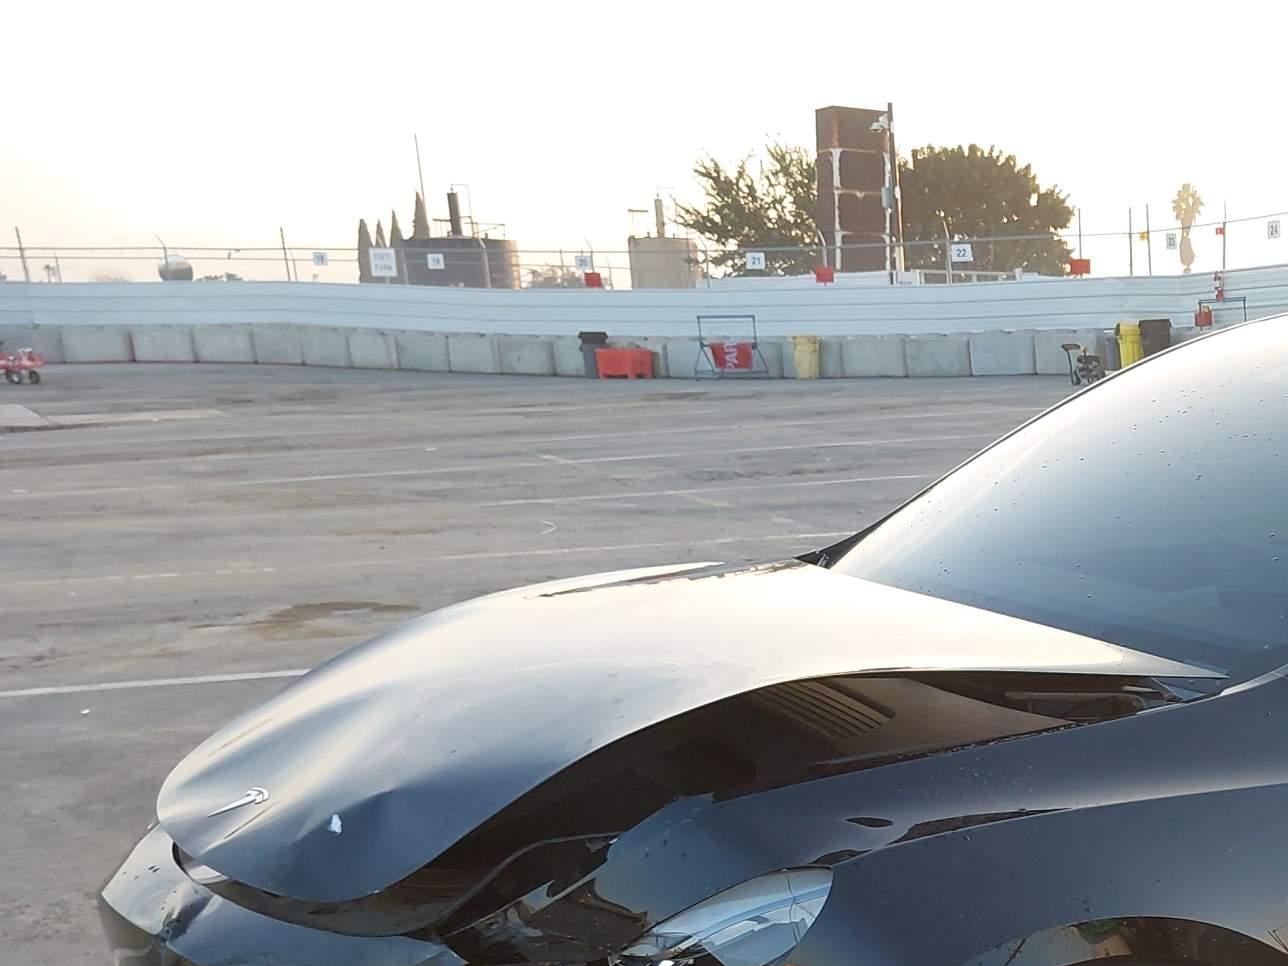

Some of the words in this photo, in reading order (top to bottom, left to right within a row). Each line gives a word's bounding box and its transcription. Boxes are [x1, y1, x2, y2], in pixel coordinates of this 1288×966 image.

[1270, 225, 1278, 236] 24
[956, 248, 967, 258] 22
[752, 256, 761, 265] 21
